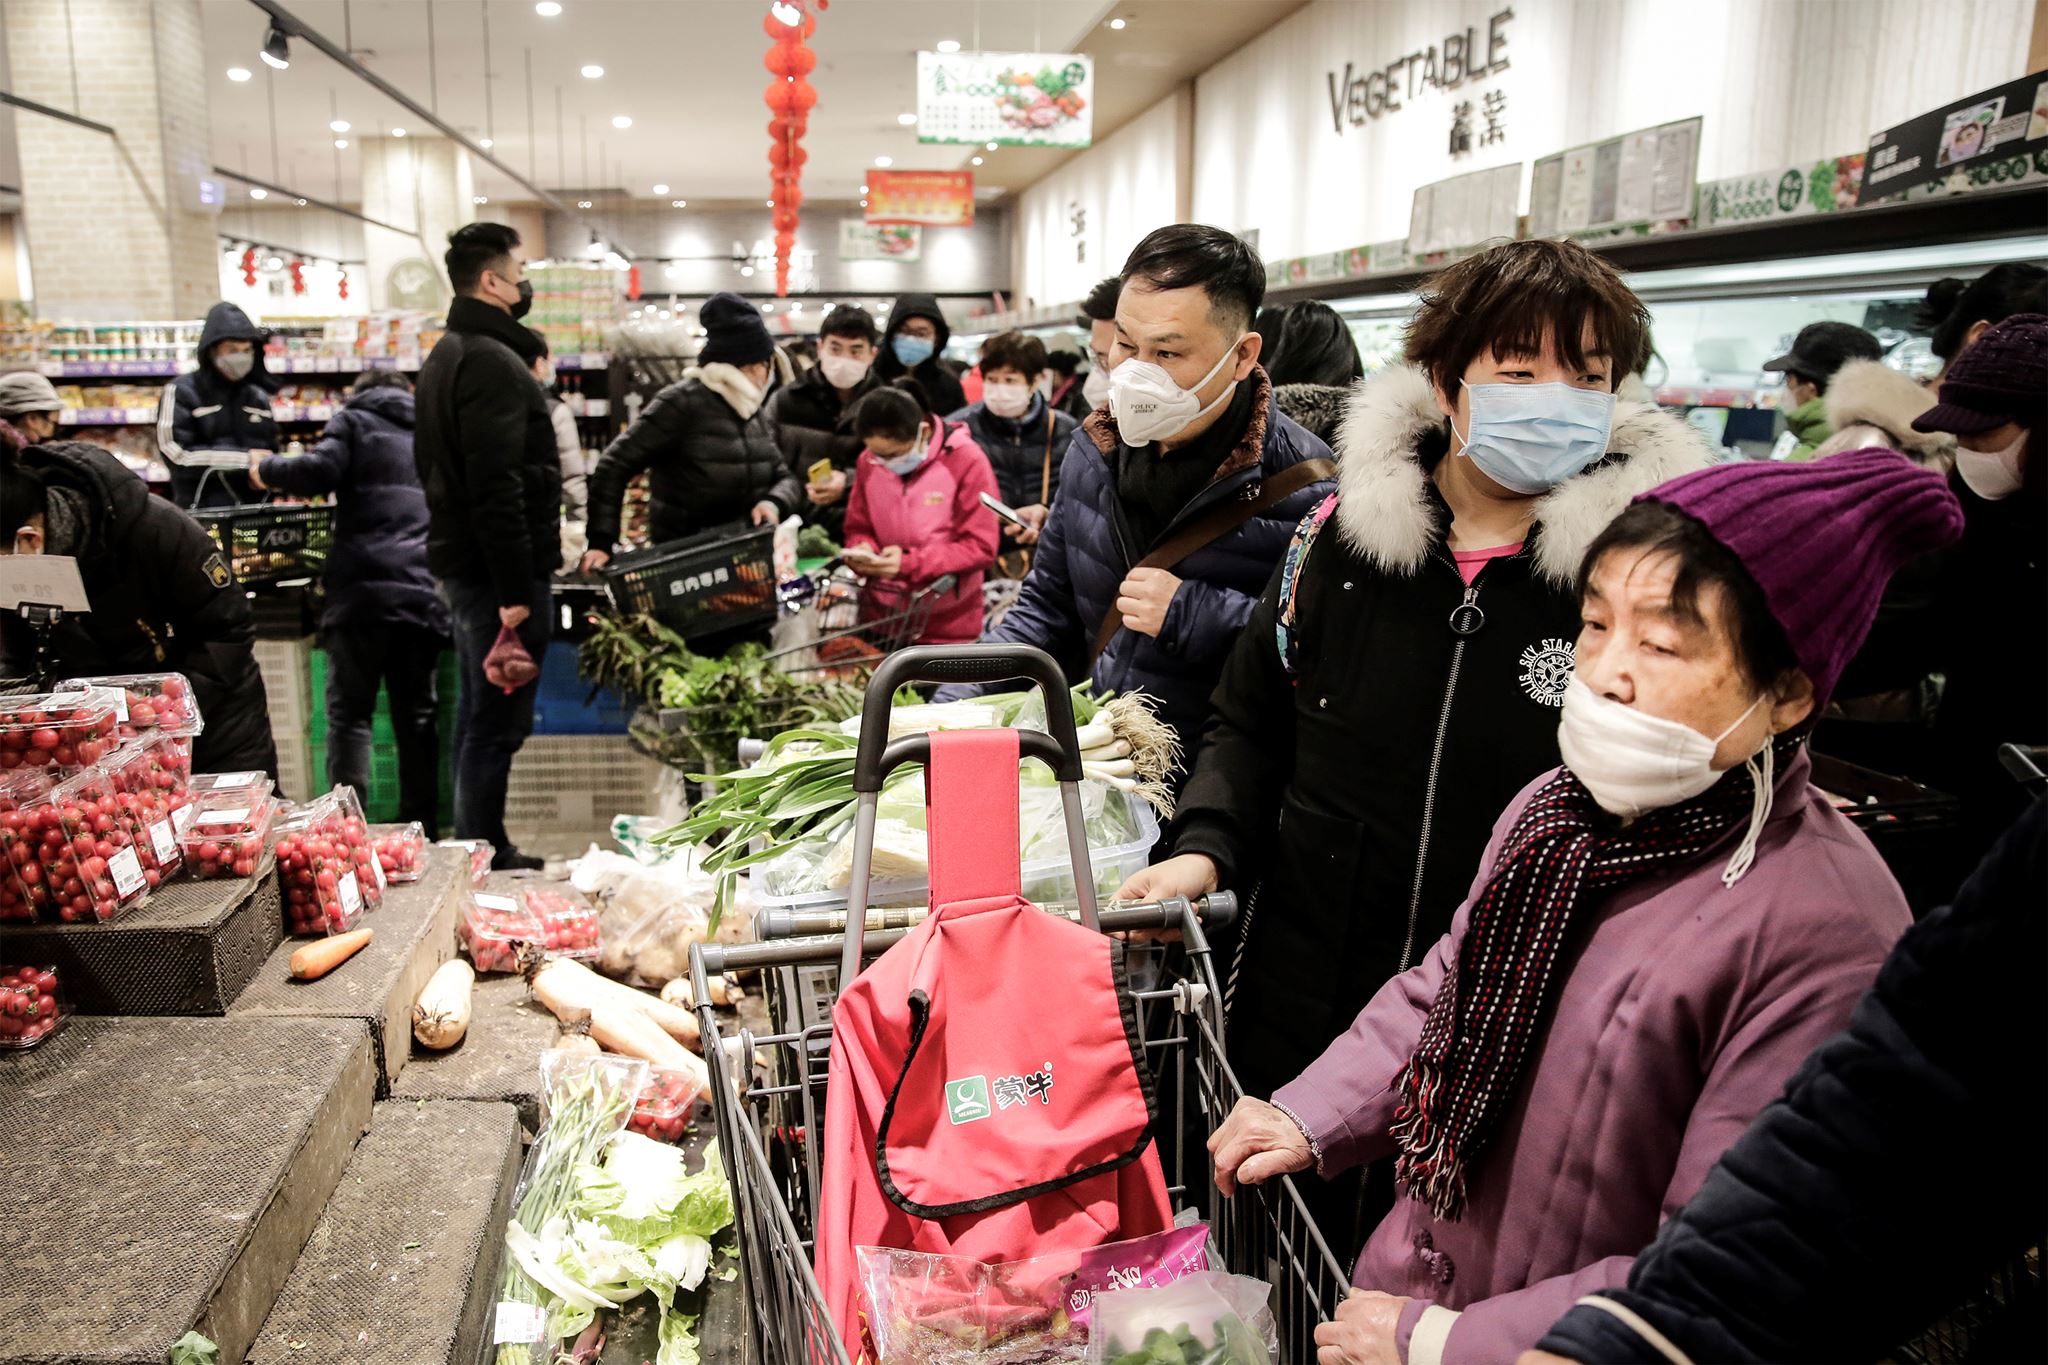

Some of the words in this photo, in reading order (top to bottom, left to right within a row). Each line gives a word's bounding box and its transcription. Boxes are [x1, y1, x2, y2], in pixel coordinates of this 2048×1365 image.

[1328, 6, 1514, 137] VEGETABLE
[1519, 644, 1540, 668] SKY
[993, 1071, 1053, 1110] 蒙牛
